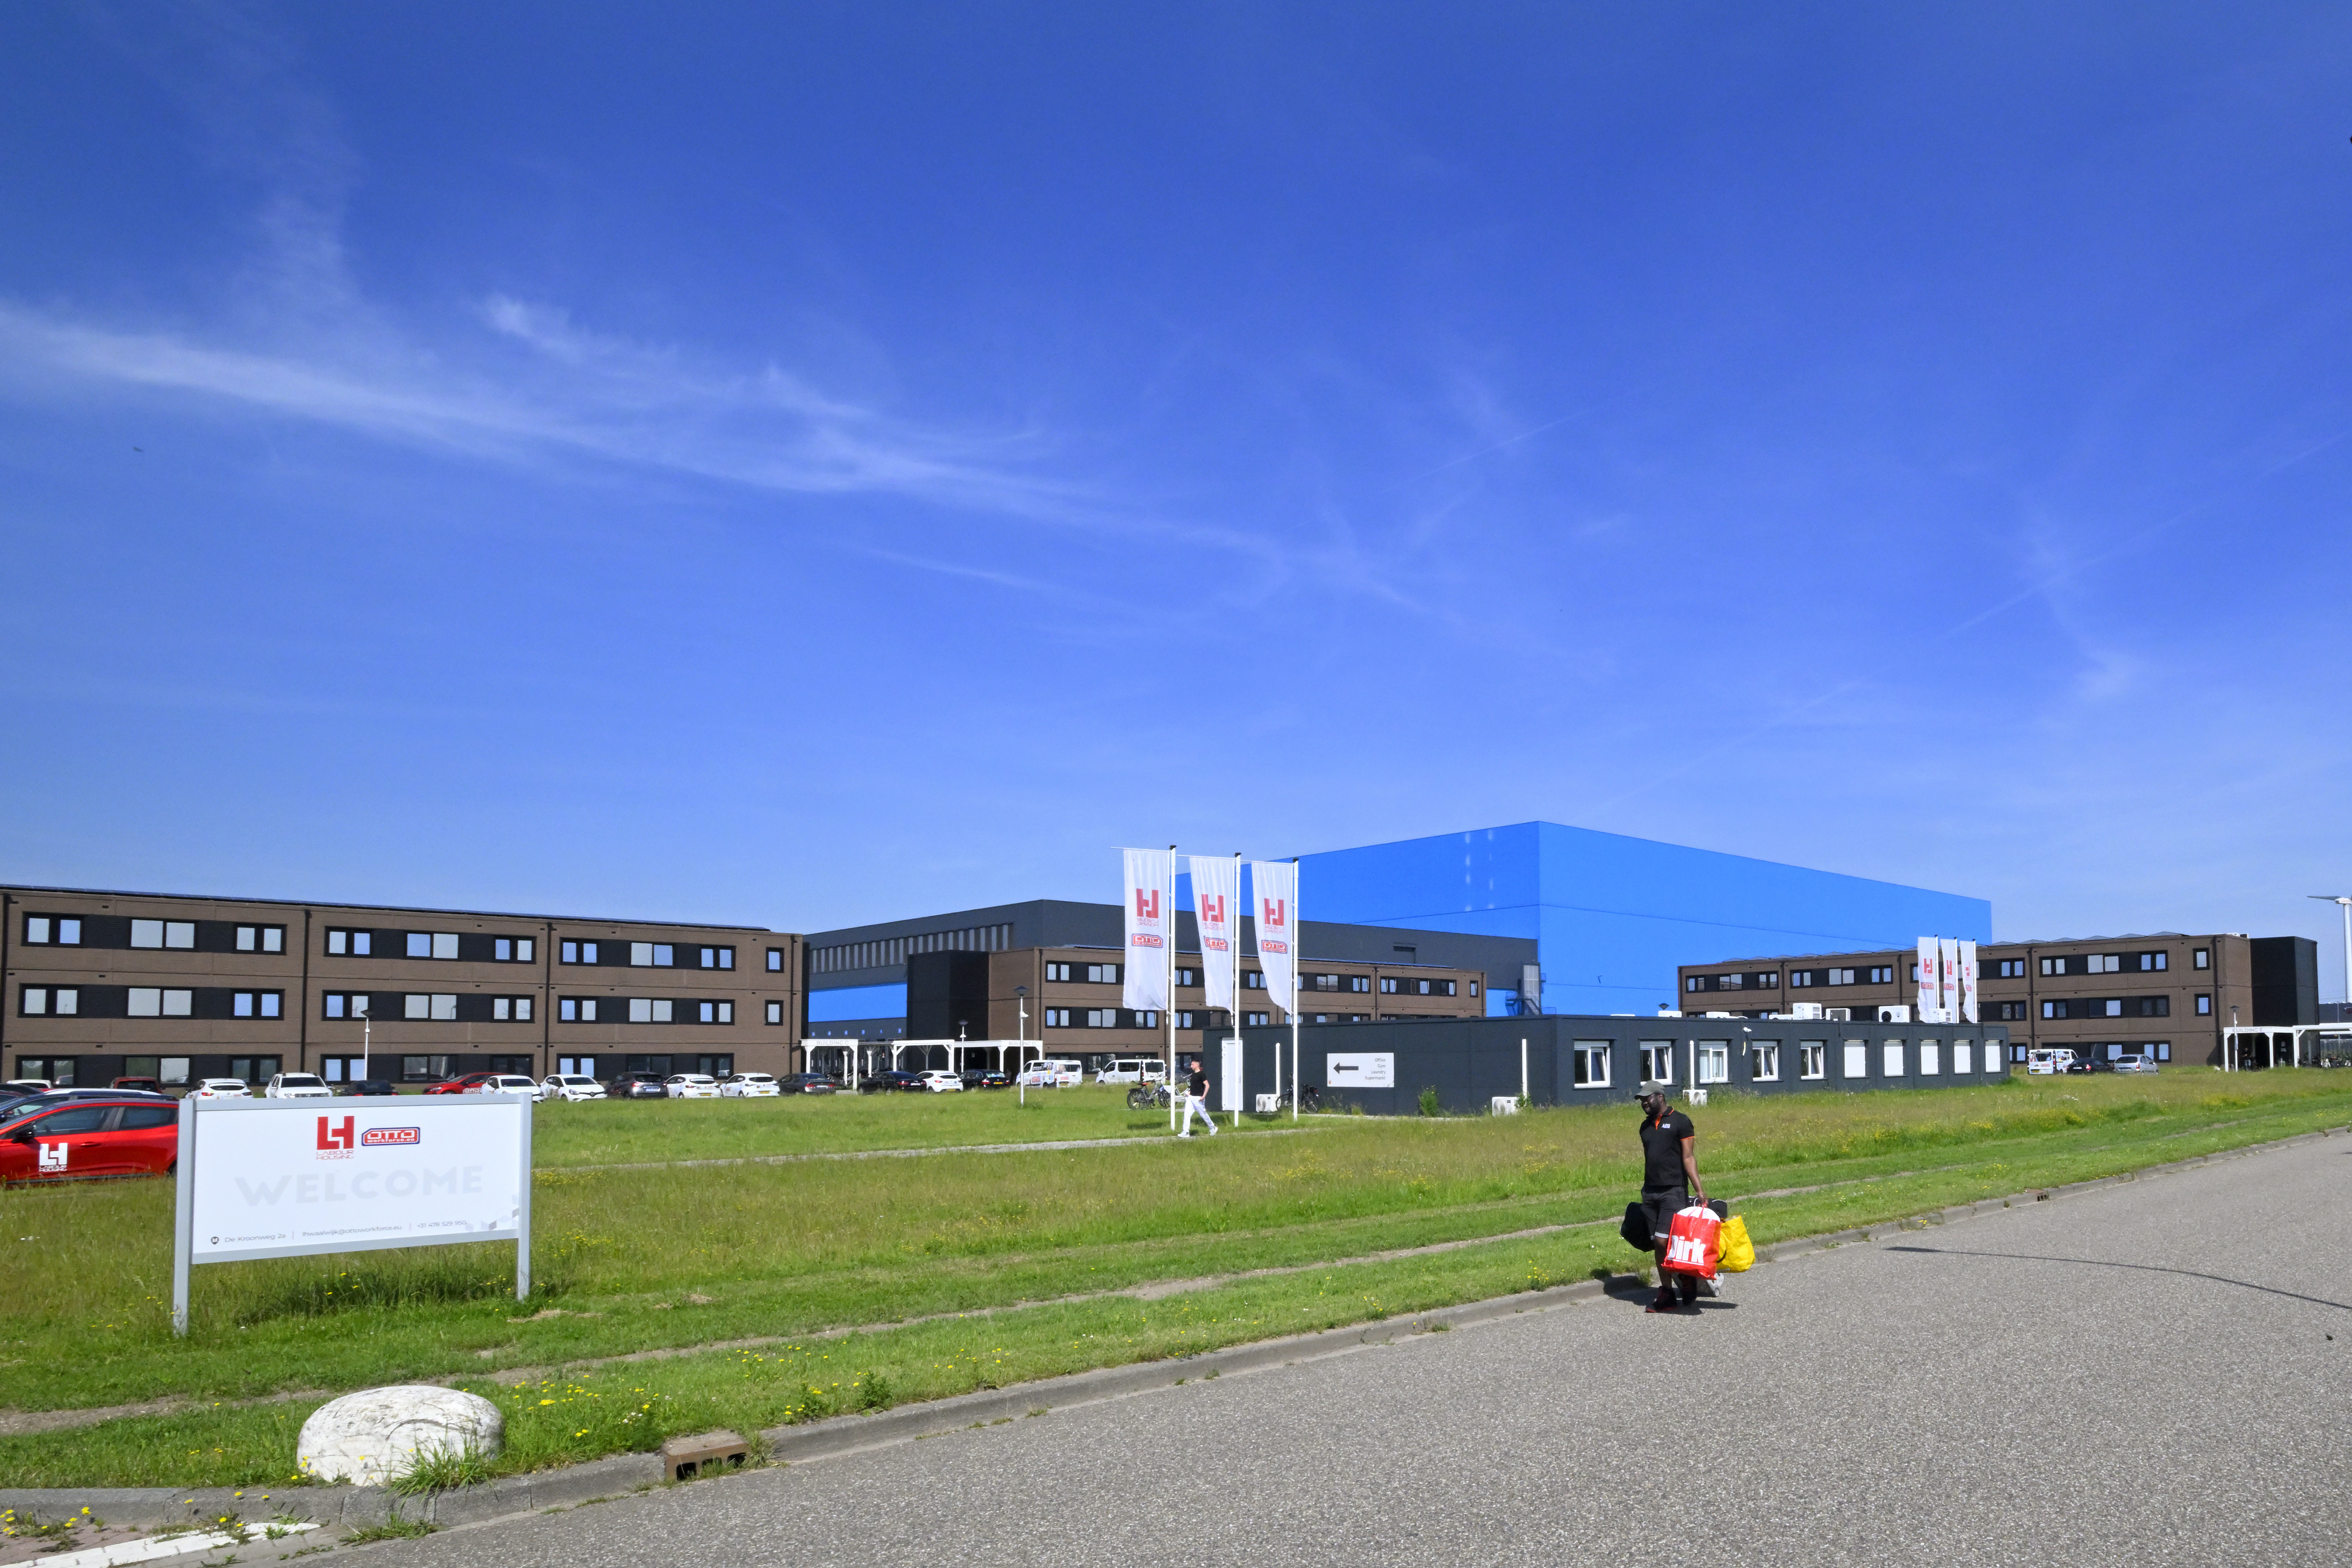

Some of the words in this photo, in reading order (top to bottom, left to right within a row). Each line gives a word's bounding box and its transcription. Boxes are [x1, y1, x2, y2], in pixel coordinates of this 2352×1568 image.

[367, 1130, 415, 1139] OTTO
[234, 1165, 483, 1207] WELCOME
[1667, 1235, 1706, 1263] Dirk
